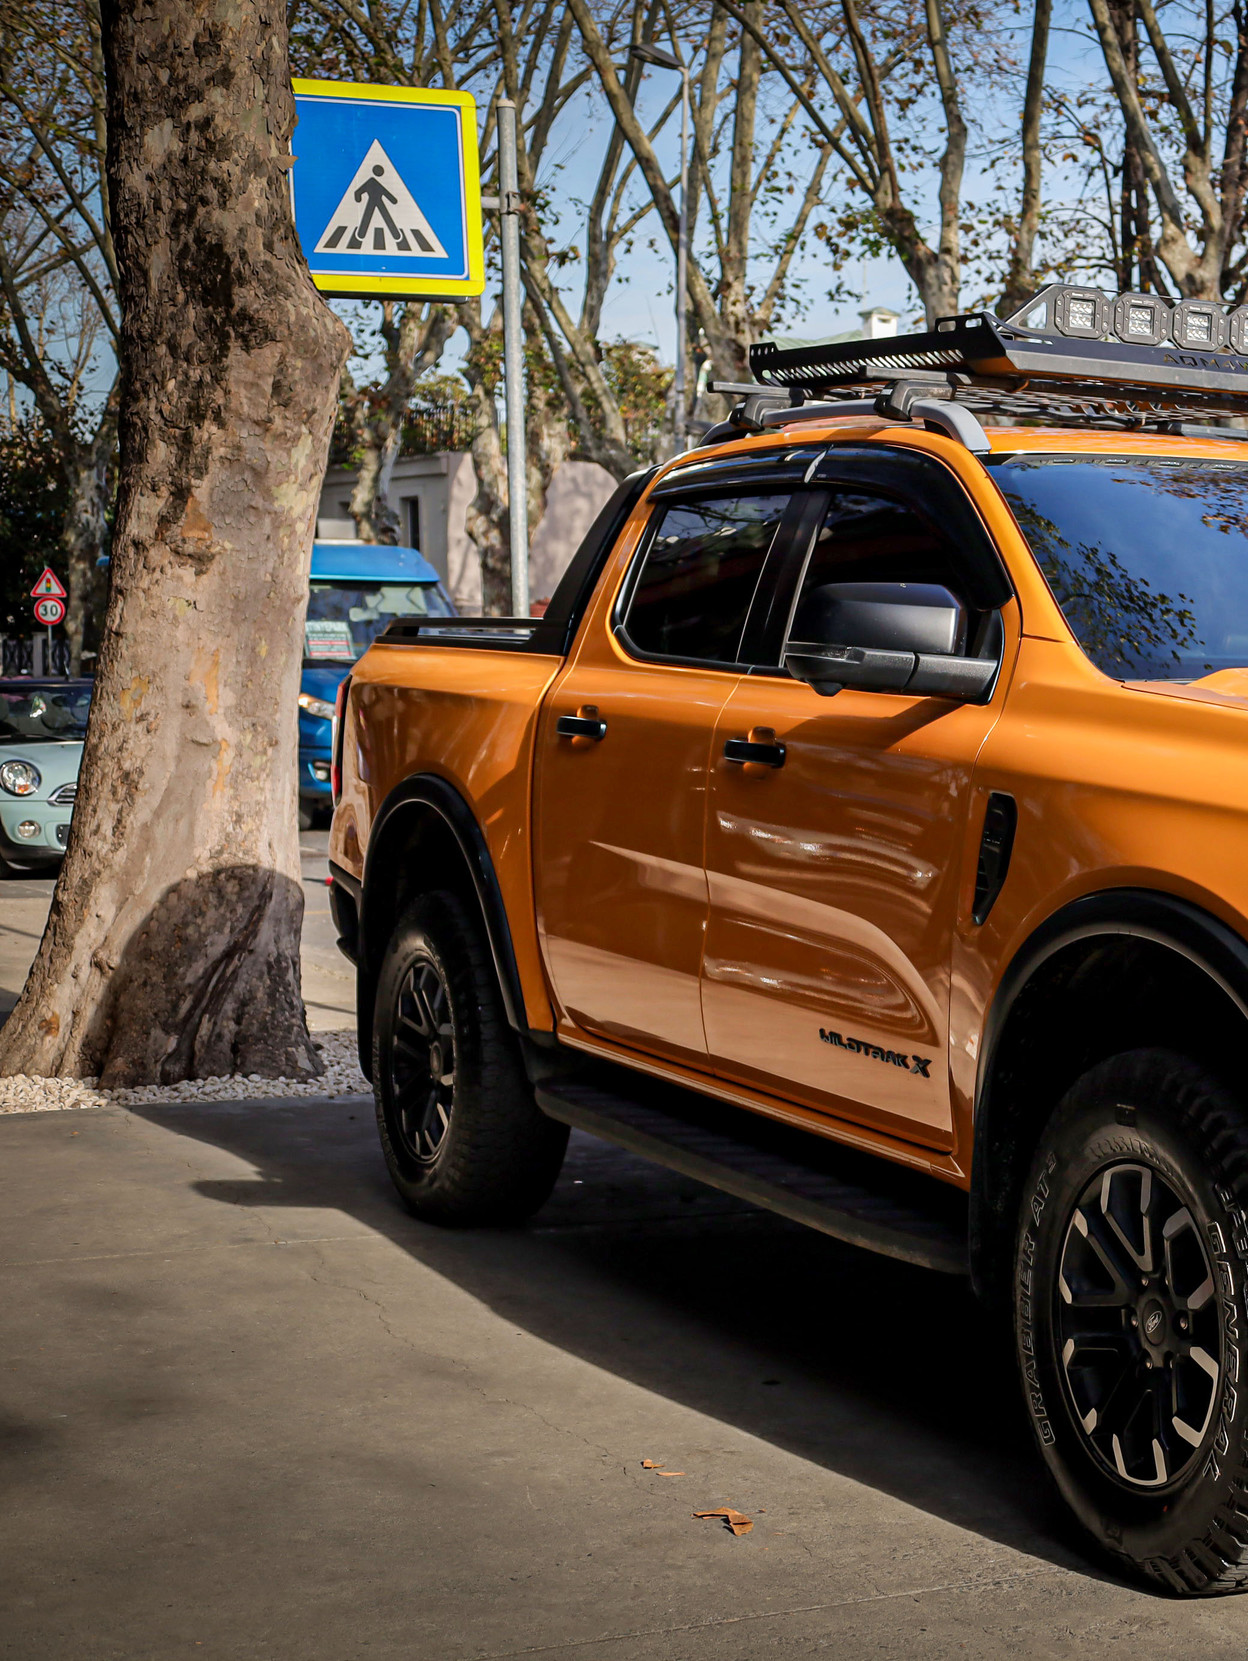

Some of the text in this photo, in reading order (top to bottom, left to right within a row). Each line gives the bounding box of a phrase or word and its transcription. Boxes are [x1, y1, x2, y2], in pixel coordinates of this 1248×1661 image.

[40, 604, 58, 617] 30
[819, 1027, 933, 1079] WILDTRAK X
[1018, 1232, 1056, 1447] GRABBER
[1202, 1220, 1240, 1482] GENERAL
